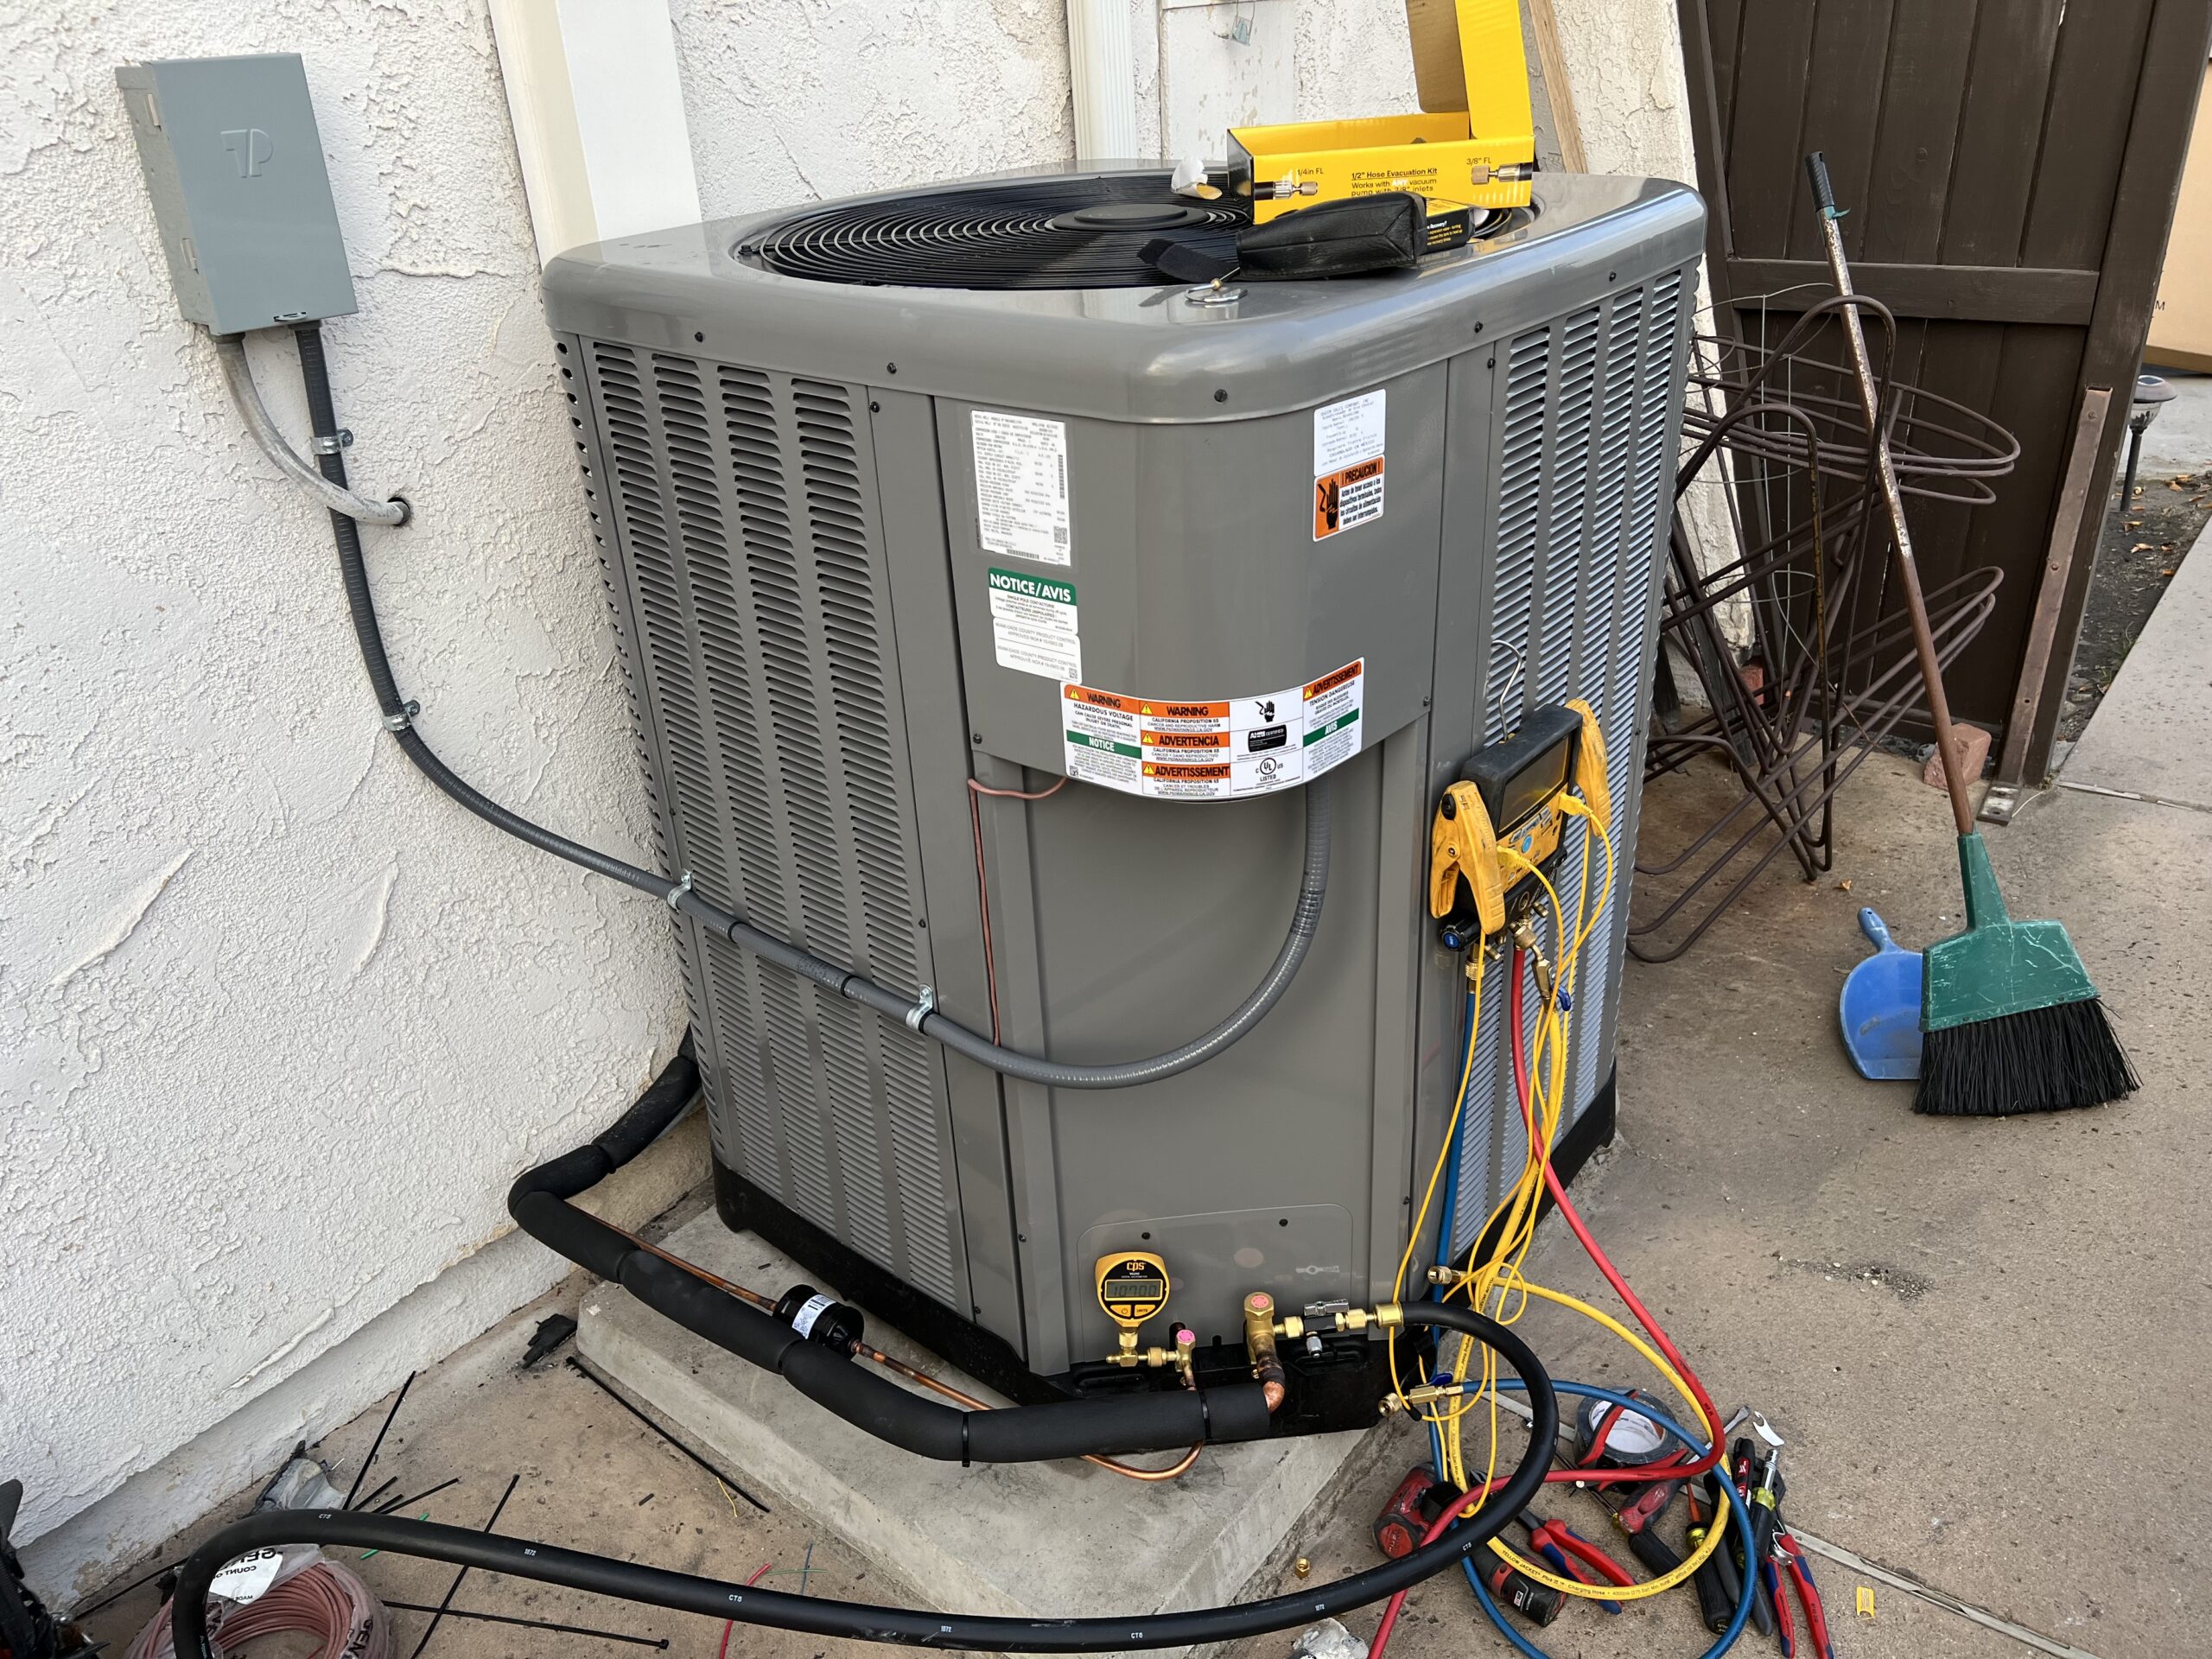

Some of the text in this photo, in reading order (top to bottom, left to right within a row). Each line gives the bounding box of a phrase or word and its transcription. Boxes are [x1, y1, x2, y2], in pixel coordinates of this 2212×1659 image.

[1387, 168, 1426, 177] Evacuation
[1313, 664, 1359, 695] ADVERTISSEMENT
[1086, 692, 1121, 709] WARNING
[1309, 694, 1328, 707] TENSION
[1073, 702, 1134, 721] HAZARDOUS VOLTAGE
[1166, 706, 1209, 716] WARNING
[1325, 721, 1338, 735] AVIS
[1089, 737, 1115, 752] NOTICE
[1159, 734, 1220, 747] ADVERTENCIA
[1155, 766, 1230, 778] ADVERTISSEMENT
[1260, 773, 1277, 782] LISTED
[1502, 1549, 1520, 1565] YELLOW
